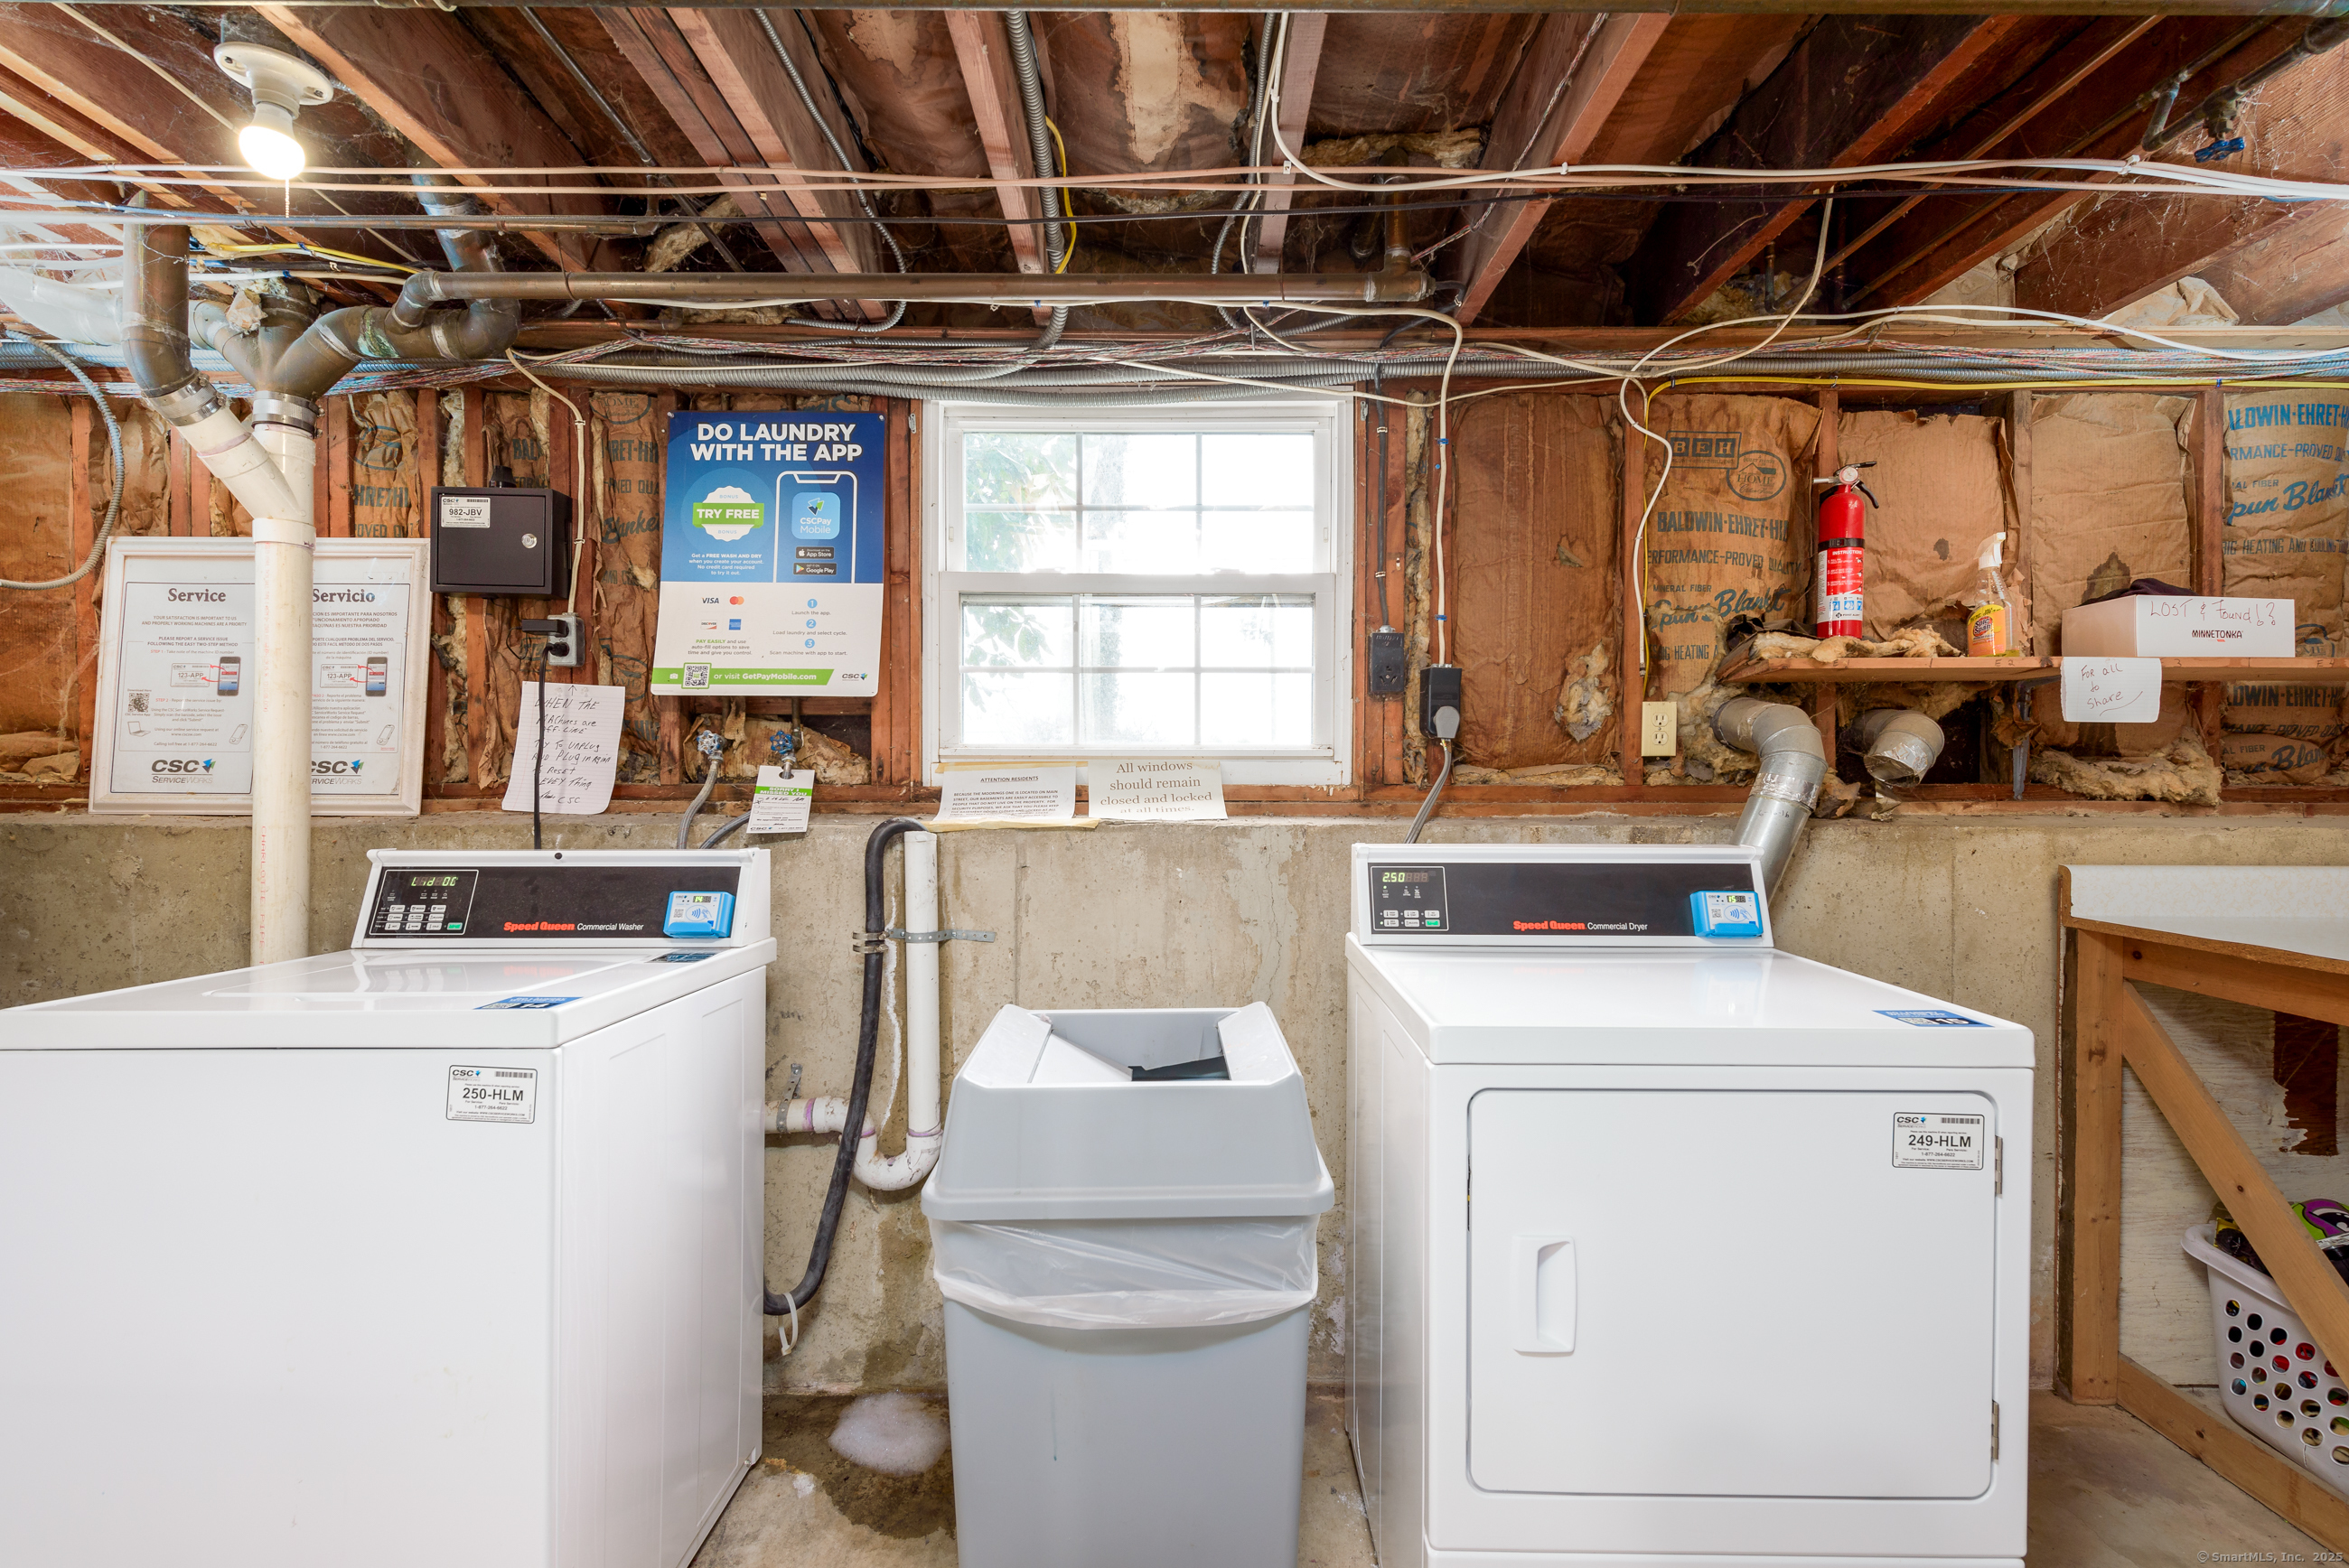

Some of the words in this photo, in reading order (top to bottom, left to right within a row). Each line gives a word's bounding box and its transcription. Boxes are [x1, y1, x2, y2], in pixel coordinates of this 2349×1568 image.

[697, 424, 733, 441] DO
[740, 424, 856, 442] LAUNDRY
[690, 443, 753, 461] WITH
[760, 443, 808, 461] THE
[813, 443, 862, 462] APP
[1737, 473, 1775, 484] HOME
[2252, 479, 2279, 489] FIBER
[697, 509, 723, 518] TRY
[725, 509, 760, 518] FREE
[800, 518, 832, 526] CSCPay
[800, 525, 831, 534] Mobile
[2242, 538, 2284, 555] HEATING
[2288, 537, 2307, 553] AND
[1768, 556, 1802, 575] QUALITY
[1652, 584, 1686, 593] MINERAL
[1689, 584, 1712, 593] FIBER
[167, 587, 227, 602] Service
[313, 588, 376, 602] Servicio
[2150, 599, 2193, 617] LOST
[2191, 630, 2242, 639] MINNETONKA
[1674, 644, 1709, 660] HEATING
[742, 672, 817, 681] GetPayMobile.com
[2090, 681, 2101, 692] to
[151, 759, 200, 773] CSC
[1116, 762, 1134, 773] All
[1137, 761, 1193, 772] windows
[1109, 778, 1153, 790] should
[1156, 777, 1201, 789] remain
[1100, 795, 1140, 806] closed
[1144, 794, 1167, 804] and
[1171, 792, 1212, 802] locked
[1382, 872, 1406, 882] 2.50
[503, 921, 539, 932] Speed
[539, 921, 576, 930] Queen
[576, 922, 618, 930] Commercial
[1512, 920, 1549, 931] Speed
[1549, 920, 1586, 930] Queen
[1586, 922, 1627, 930] Commercial
[1628, 922, 1648, 931] Dryer
[452, 1069, 474, 1077] CSC
[463, 1087, 524, 1101] 250-HLM
[1896, 1115, 1920, 1124] CSC
[1908, 1134, 1971, 1148] 249-HLM
